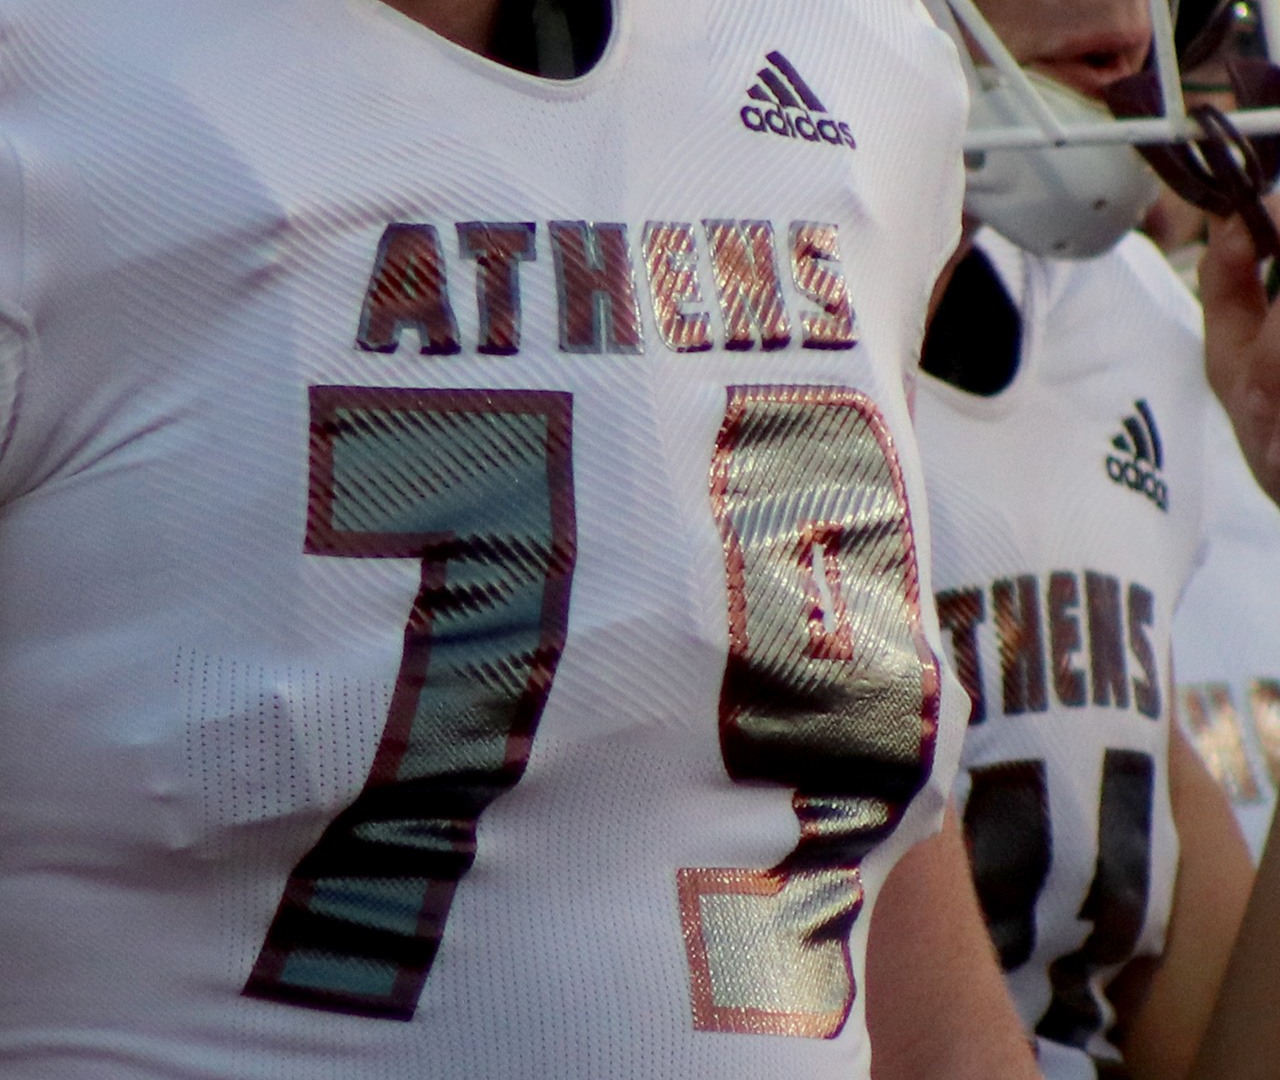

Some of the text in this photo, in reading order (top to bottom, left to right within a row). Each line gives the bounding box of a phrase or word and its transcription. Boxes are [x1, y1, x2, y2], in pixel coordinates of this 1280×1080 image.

[740, 97, 857, 150] adidas
[353, 219, 860, 357] ATHENS
[239, 383, 942, 1040] 79
[936, 568, 1162, 726] THENS
